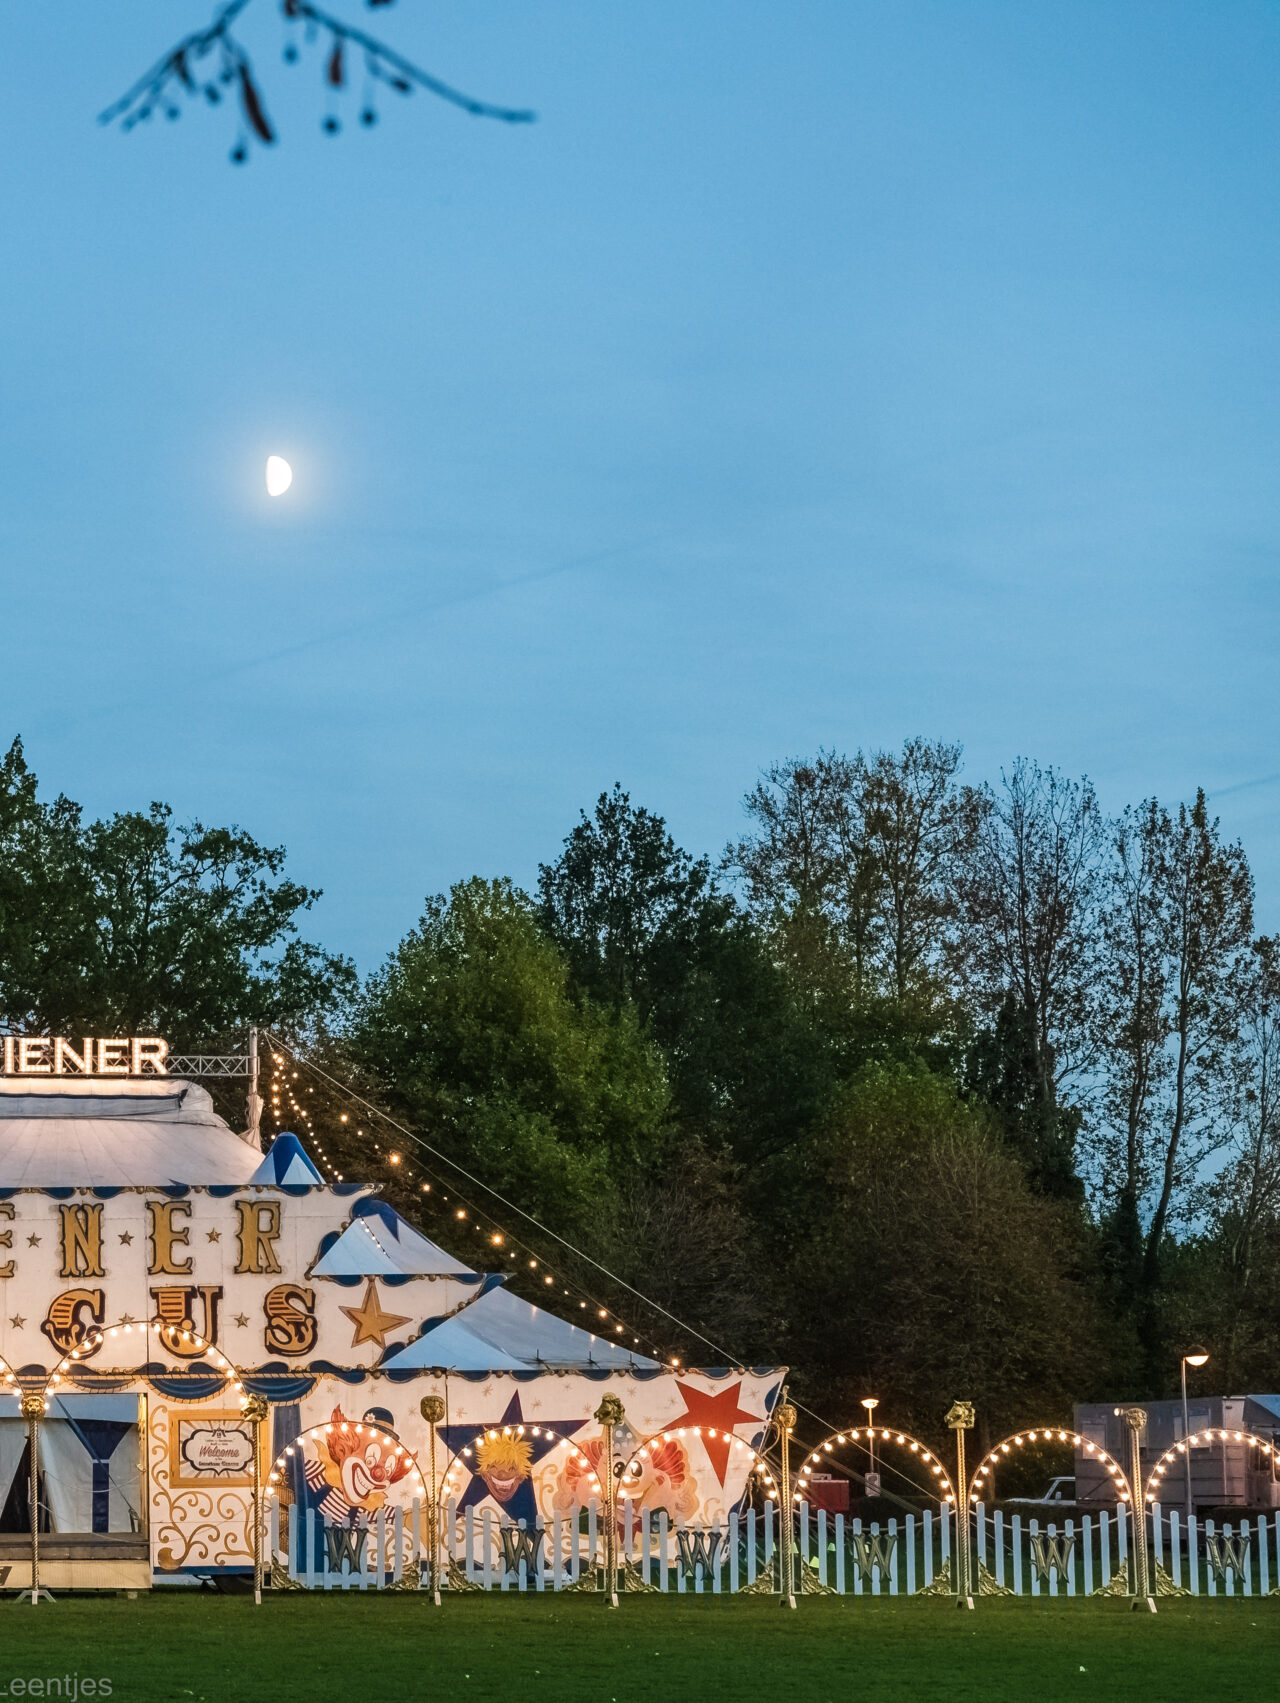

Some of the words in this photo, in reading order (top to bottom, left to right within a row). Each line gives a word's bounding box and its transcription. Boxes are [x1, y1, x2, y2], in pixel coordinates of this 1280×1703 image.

[199, 1445, 239, 1457] Welcome
[323, 1526, 366, 1574] W
[499, 1527, 546, 1577] W
[675, 1530, 721, 1580] W
[853, 1533, 898, 1582] W
[1029, 1534, 1076, 1583] W
[1205, 1534, 1250, 1583] W
